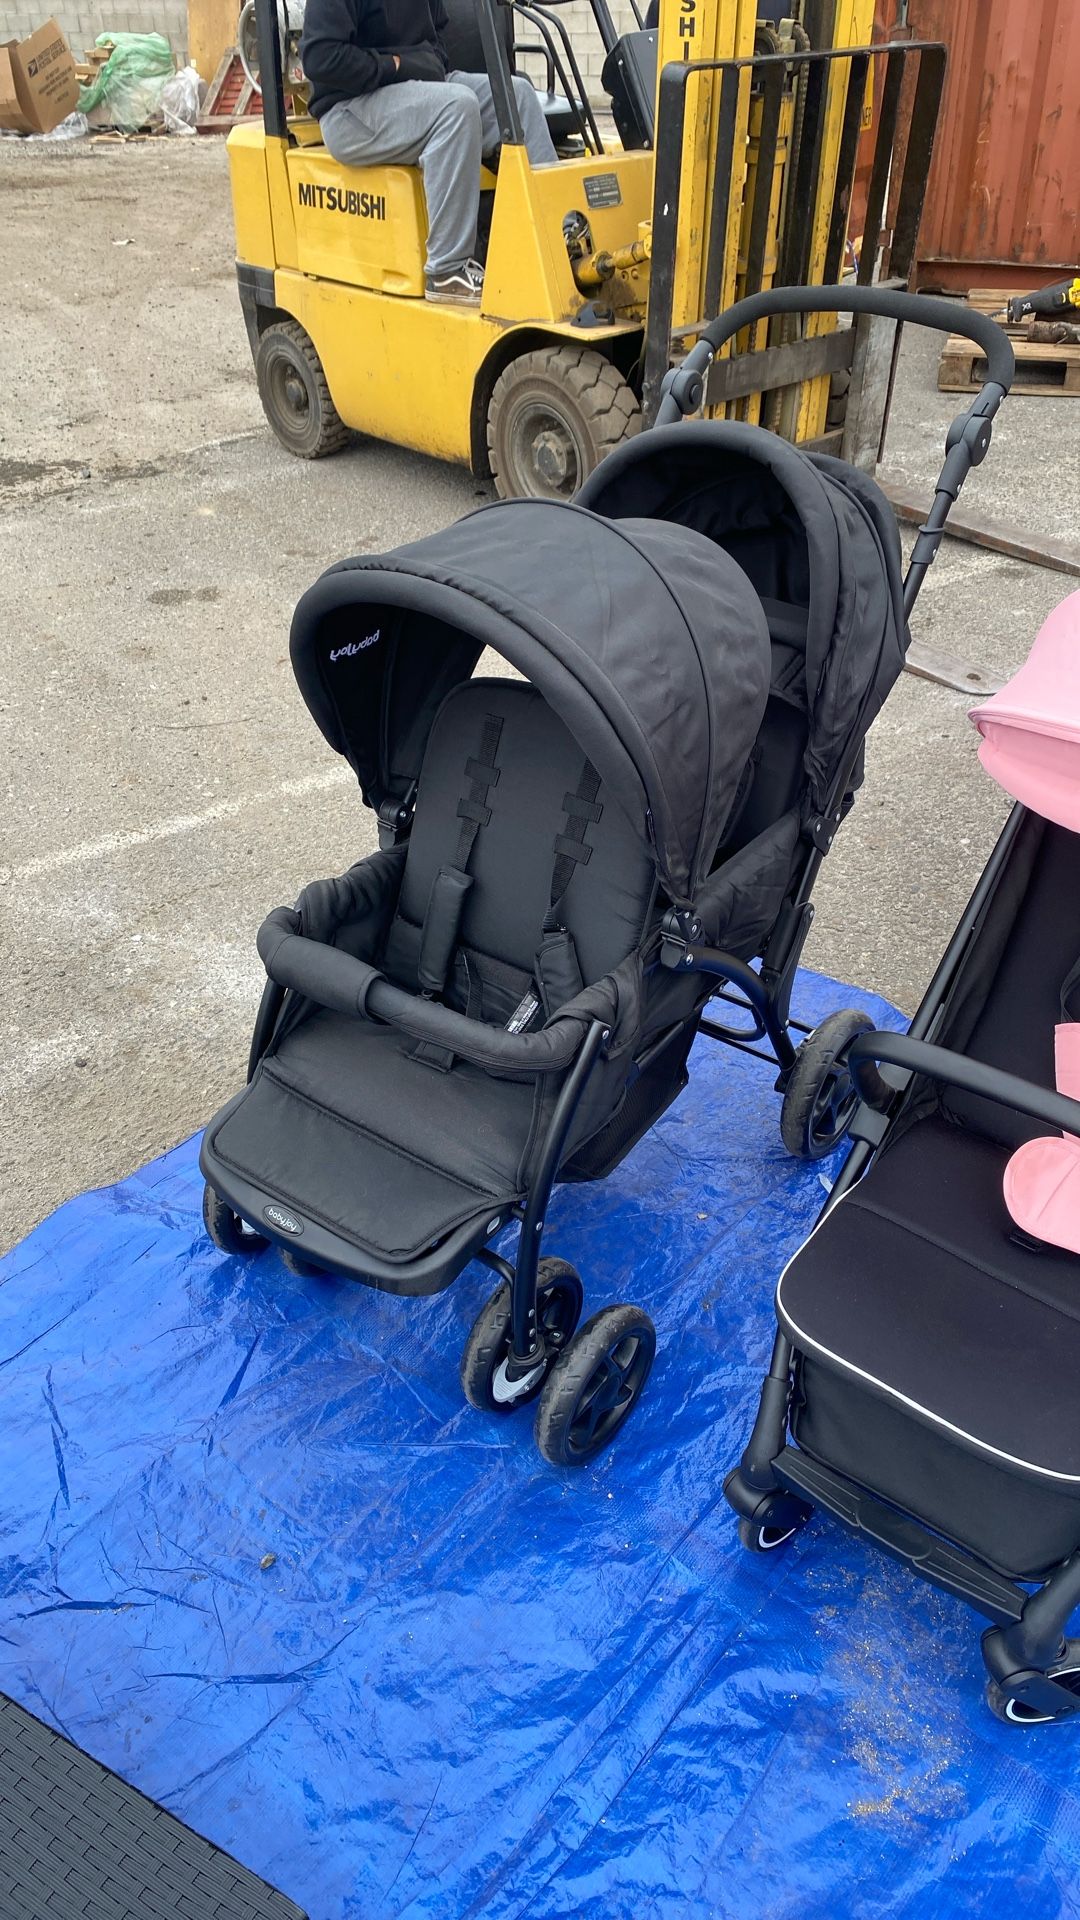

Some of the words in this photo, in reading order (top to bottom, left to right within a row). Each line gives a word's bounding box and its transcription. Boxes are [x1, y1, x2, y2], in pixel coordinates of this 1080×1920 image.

[298, 183, 386, 221] MITSUBISHI
[1022, 302, 1032, 311] XR
[268, 1208, 297, 1231] babyjoy
